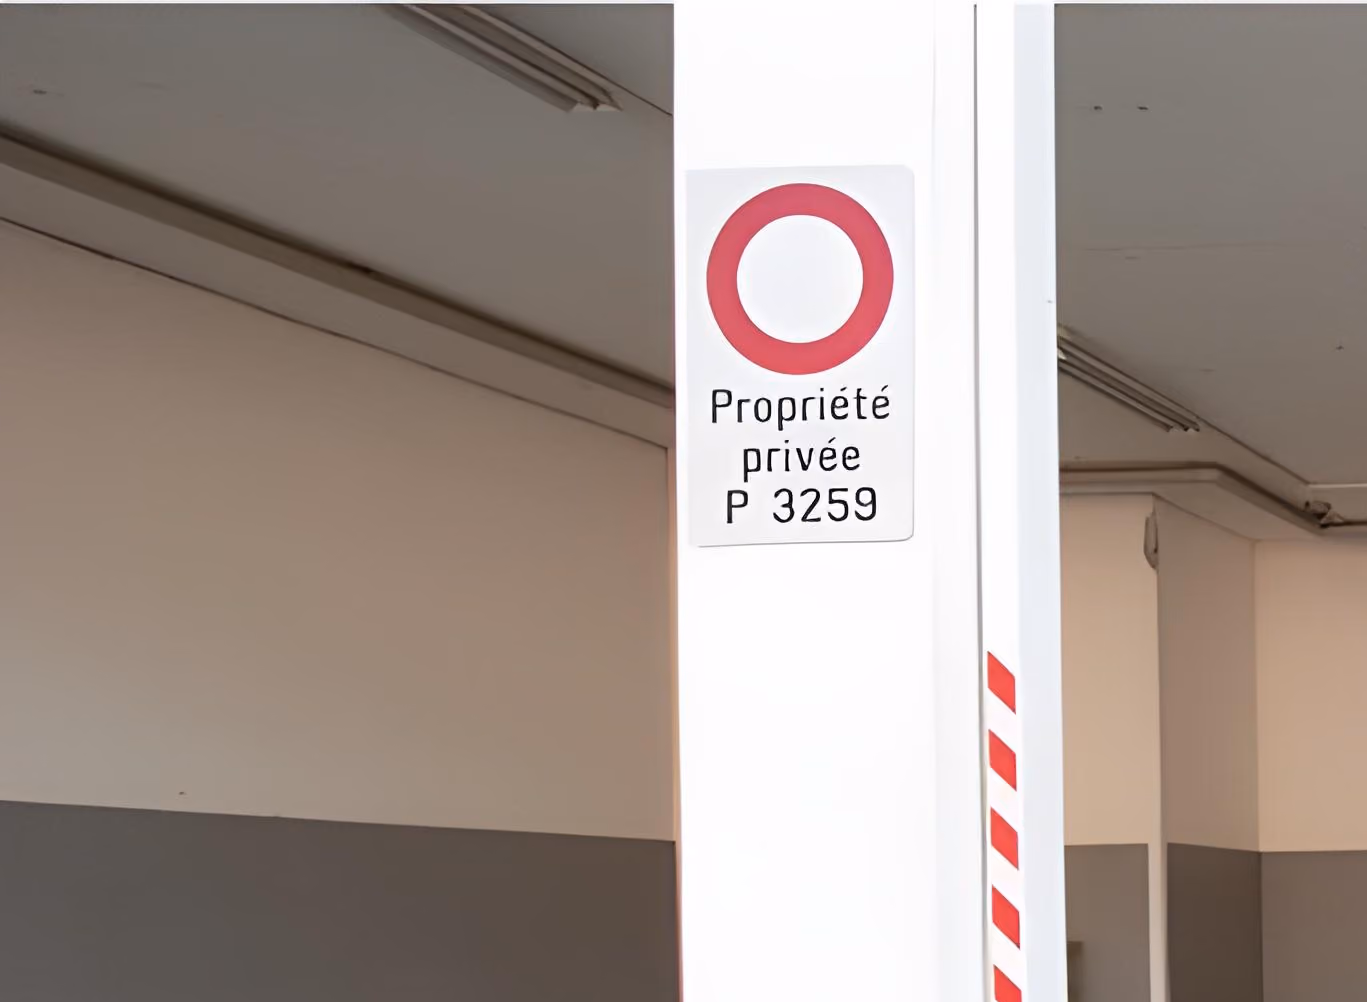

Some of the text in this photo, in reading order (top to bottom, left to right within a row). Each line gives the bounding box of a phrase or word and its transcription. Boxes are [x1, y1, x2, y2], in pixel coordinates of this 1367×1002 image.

[711, 384, 890, 431] Propriété
[742, 437, 861, 482] privée
[726, 487, 878, 523] P 3259
